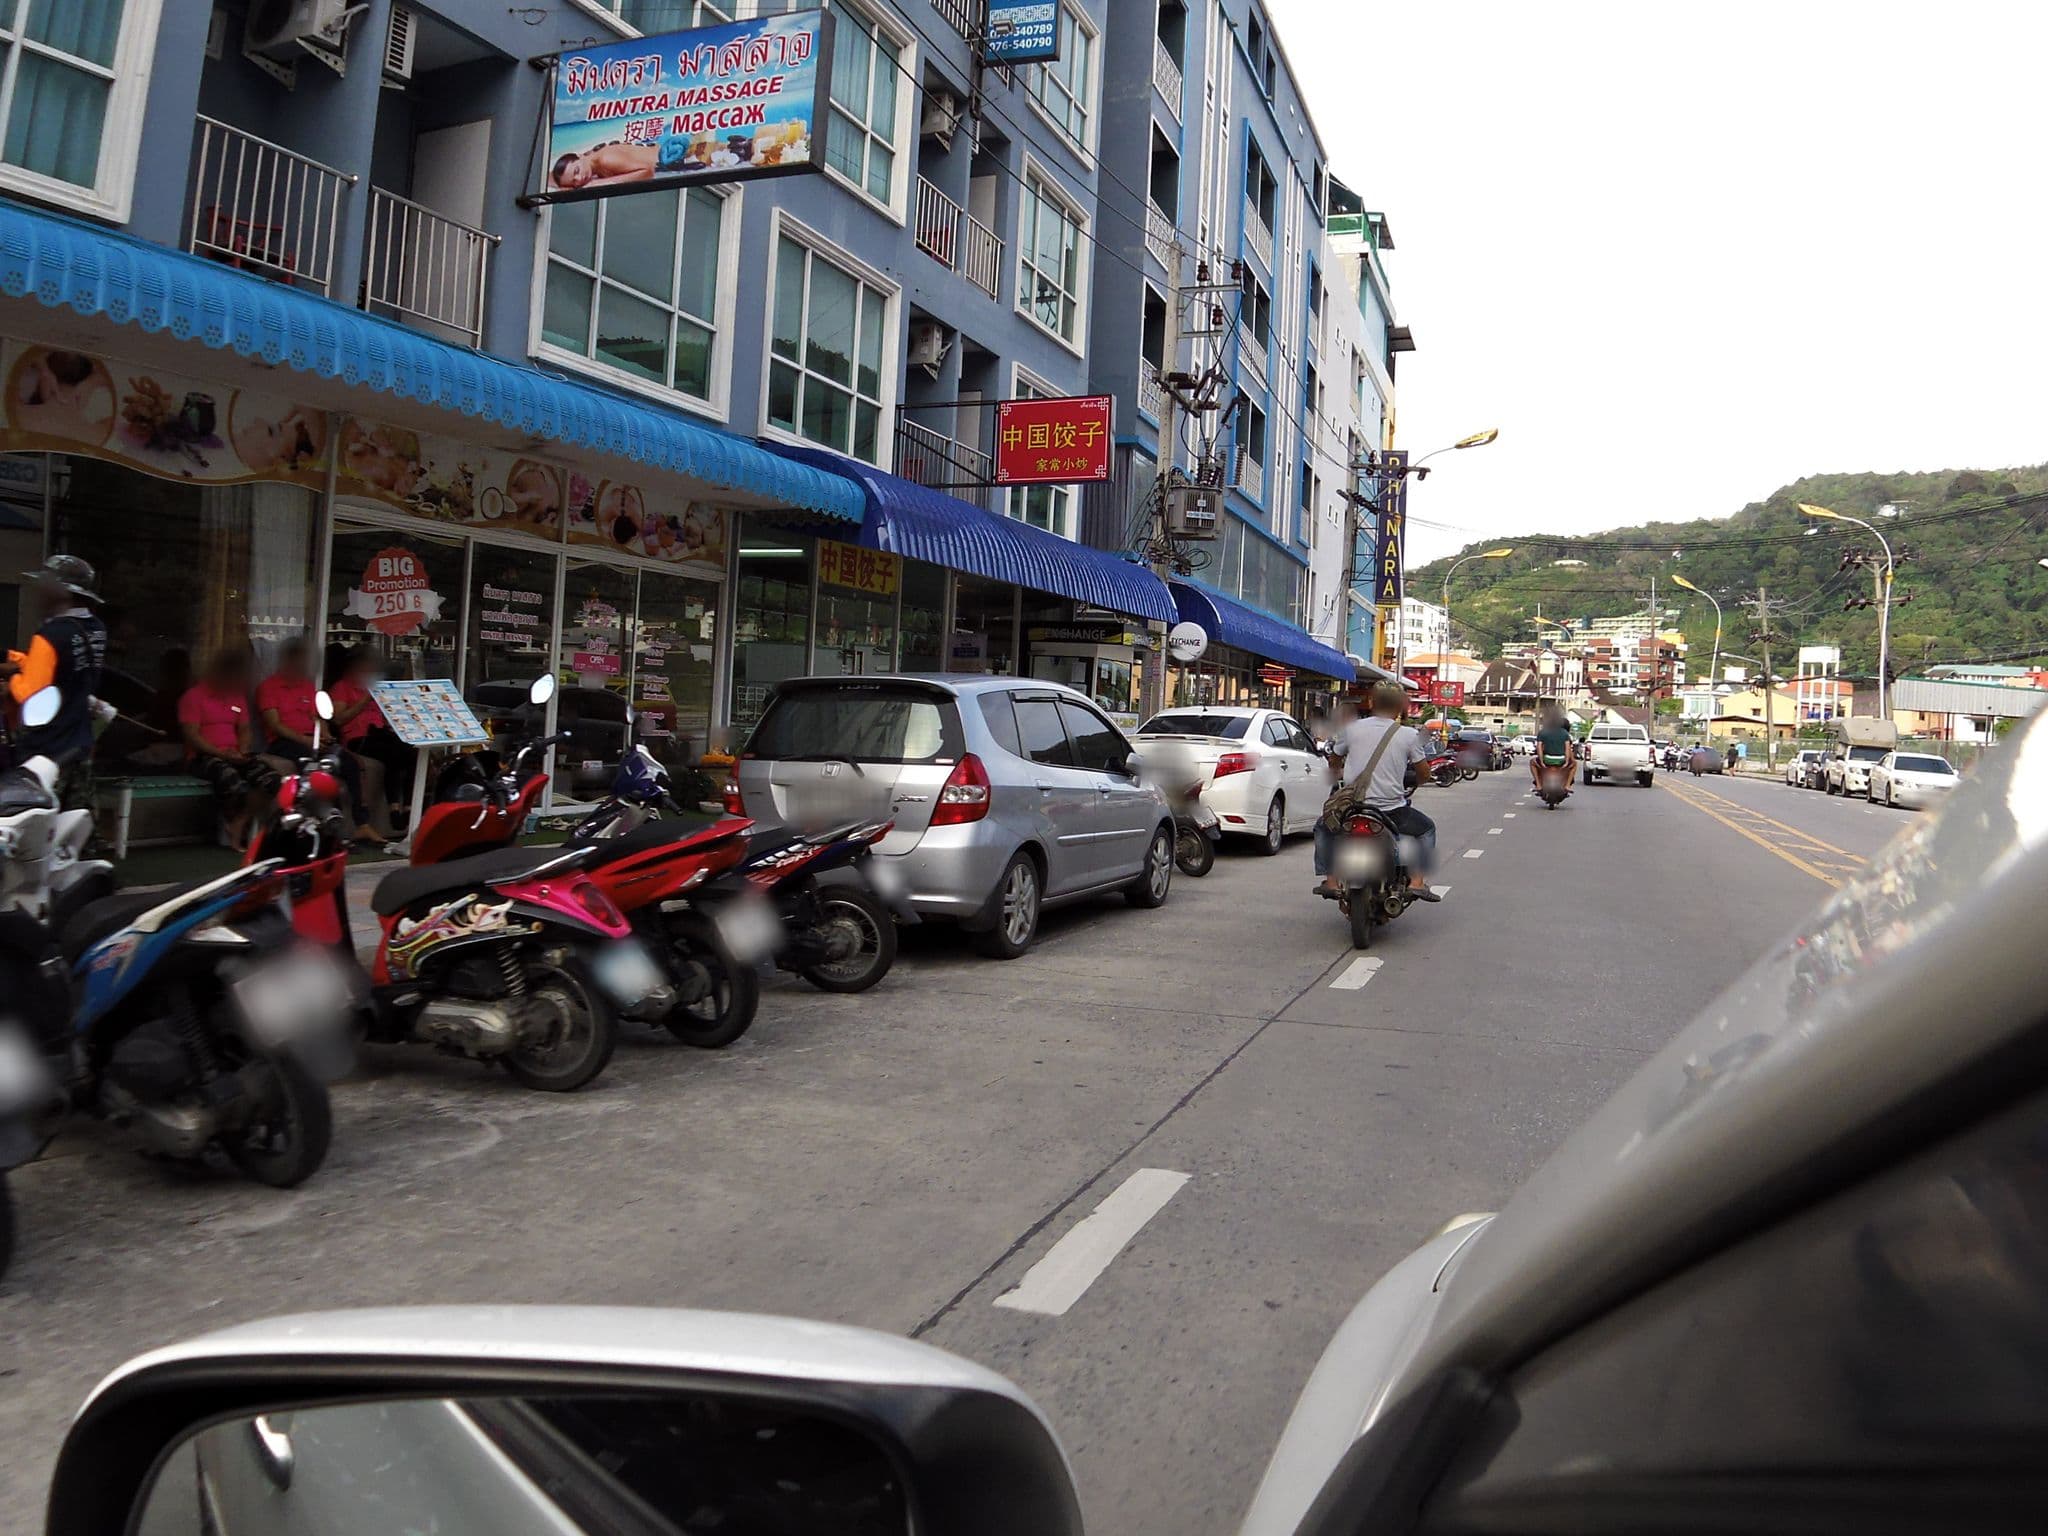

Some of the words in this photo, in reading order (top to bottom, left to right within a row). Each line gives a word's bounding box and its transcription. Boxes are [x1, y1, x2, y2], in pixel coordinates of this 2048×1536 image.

[990, 24, 1053, 38] 0-540789
[567, 54, 662, 95] มินตรา
[588, 94, 669, 121] MINTRA
[676, 76, 784, 107] MASSAGE
[624, 117, 665, 143] 按摩
[1003, 421, 1104, 451] 中国饺子
[1036, 457, 1088, 472] 家常小炒
[378, 556, 415, 577] BIG
[821, 541, 893, 592] 中国饺子
[367, 577, 426, 591] Promotion
[375, 592, 406, 614] 250
[1045, 628, 1106, 641] EXCHANGE
